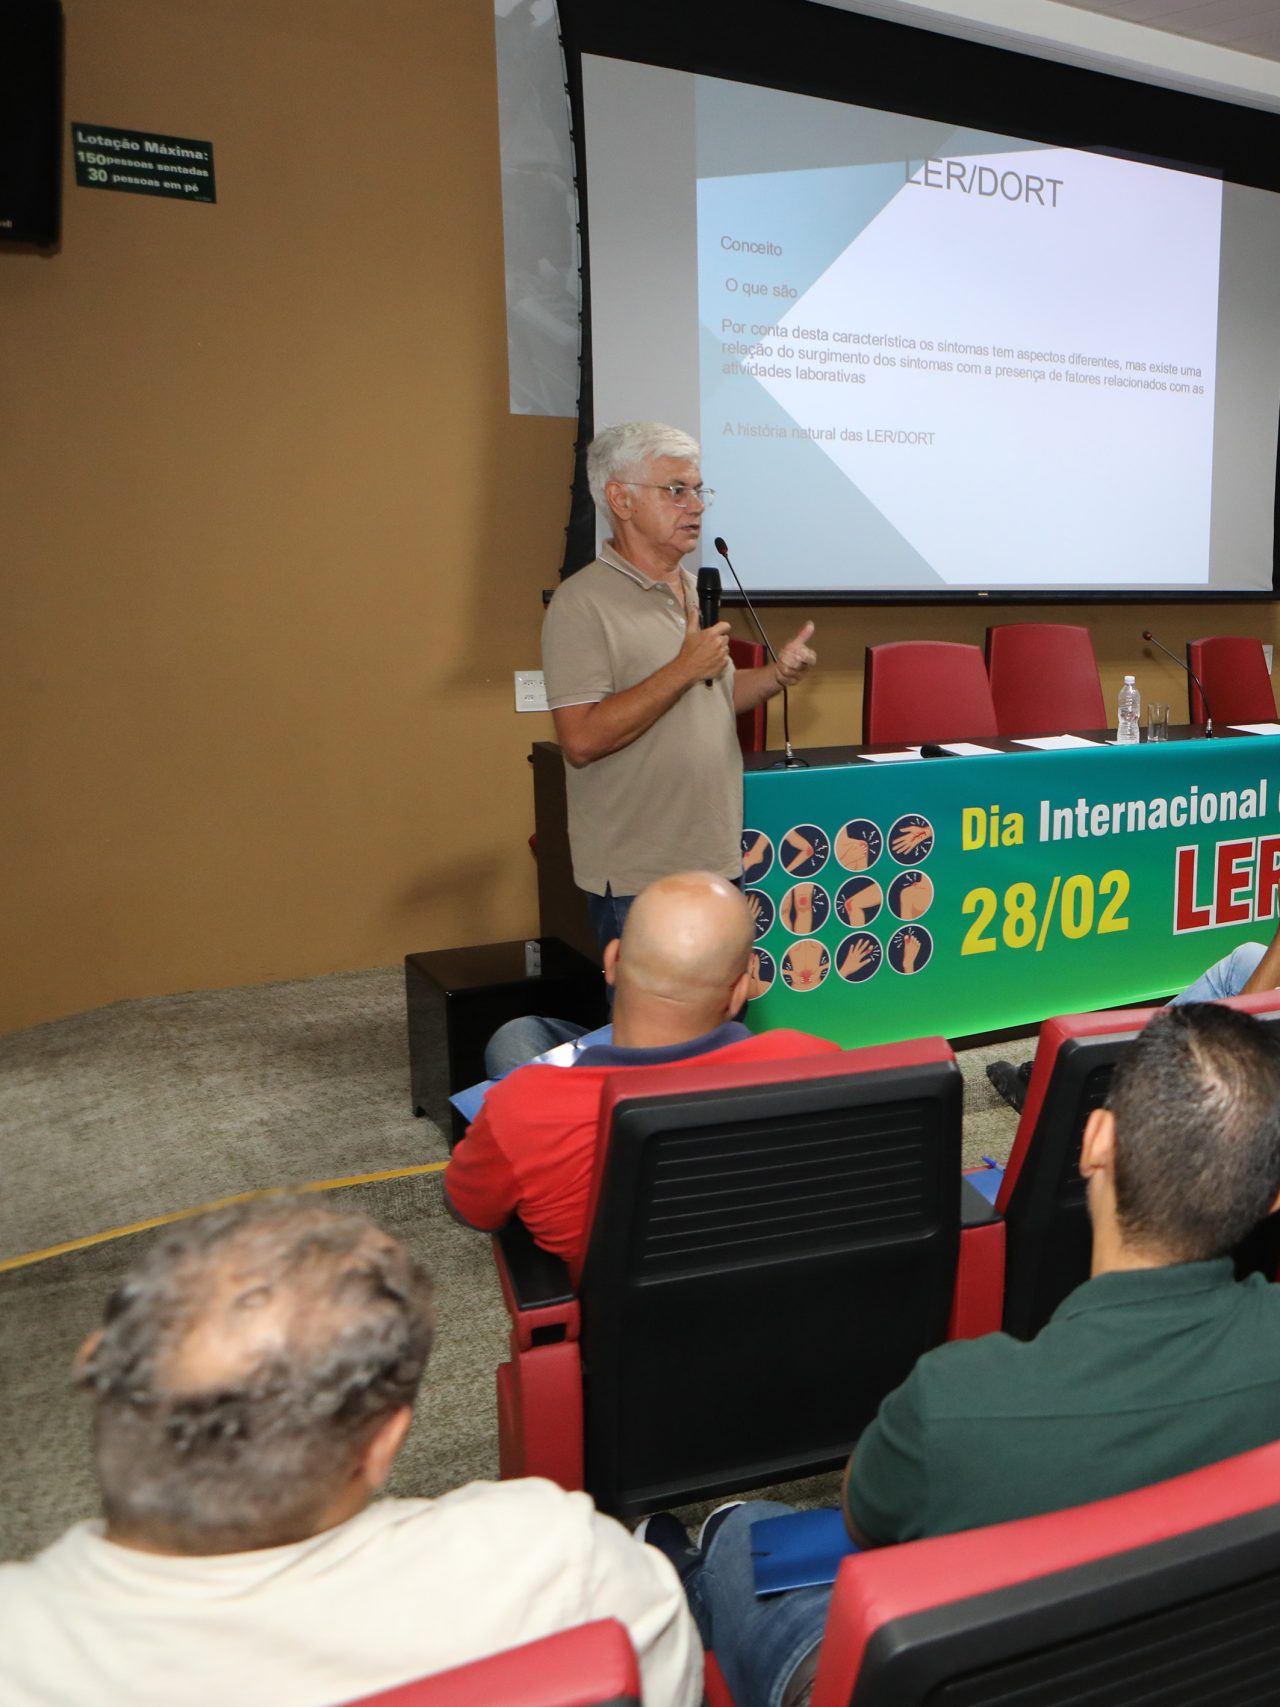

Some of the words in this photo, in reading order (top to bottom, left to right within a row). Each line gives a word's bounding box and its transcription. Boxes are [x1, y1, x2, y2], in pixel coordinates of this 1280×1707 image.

[77, 131, 140, 151] Lotação
[144, 142, 209, 161] Máxima:
[88, 168, 108, 182] 30
[112, 174, 160, 188] pessoas
[157, 161, 209, 177] sentadas
[905, 155, 1064, 208] LER/DORT
[720, 235, 783, 257] Conceito
[725, 278, 738, 292] O
[742, 281, 768, 299] que
[772, 283, 798, 299] são
[721, 318, 747, 335] Por
[751, 323, 788, 338] conta
[792, 325, 829, 341] desta
[832, 331, 916, 350] característica
[919, 339, 934, 351] os
[937, 340, 989, 356] sintomas
[992, 345, 1014, 359] tem
[1017, 349, 1066, 366] aspectos
[1068, 353, 1123, 371] diferentes,
[1125, 361, 1147, 373] mas
[1149, 362, 1178, 376] existe
[1180, 367, 1202, 378] uma
[721, 341, 773, 358] relação
[777, 345, 794, 359] do
[798, 347, 870, 367] surgimento
[873, 353, 896, 367] dos
[899, 356, 954, 372] sintomas
[956, 362, 981, 375] com
[984, 365, 992, 375] a
[995, 366, 1046, 383] presença
[1049, 369, 1063, 382] de
[1065, 370, 1101, 385] fatores
[1103, 375, 1167, 391] relacionados
[1169, 382, 1190, 394] com
[1192, 384, 1205, 395] as
[721, 362, 792, 379] atividades
[796, 366, 866, 384] laborativas
[722, 422, 734, 436] A
[738, 423, 788, 438] história
[791, 427, 836, 441] natural
[840, 427, 863, 442] das
[866, 428, 936, 446] LER/DORT
[962, 804, 1024, 852] Dia
[1039, 777, 1268, 843] Internacional
[960, 869, 1131, 957] 28/02
